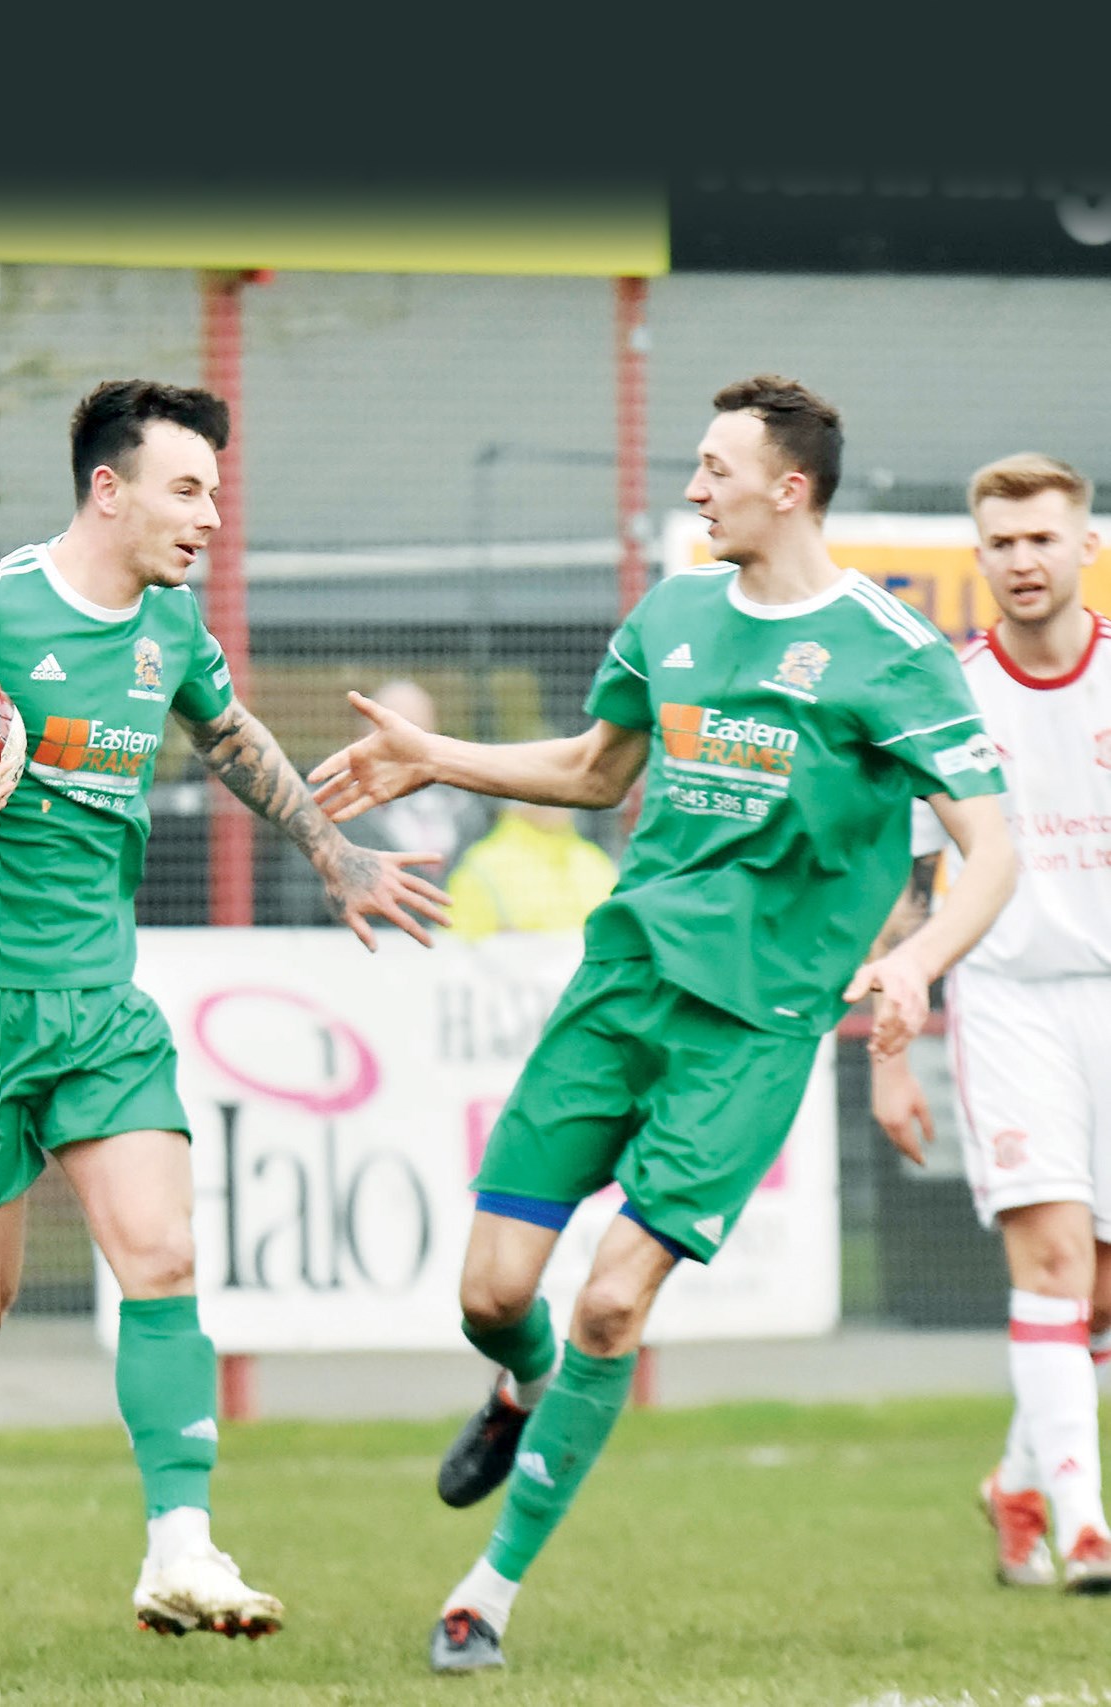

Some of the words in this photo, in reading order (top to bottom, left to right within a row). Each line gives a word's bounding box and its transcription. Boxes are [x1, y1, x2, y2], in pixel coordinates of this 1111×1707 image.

[88, 719, 158, 754] Eastern
[701, 707, 799, 752] Eastern
[696, 736, 793, 775] FRAMES
